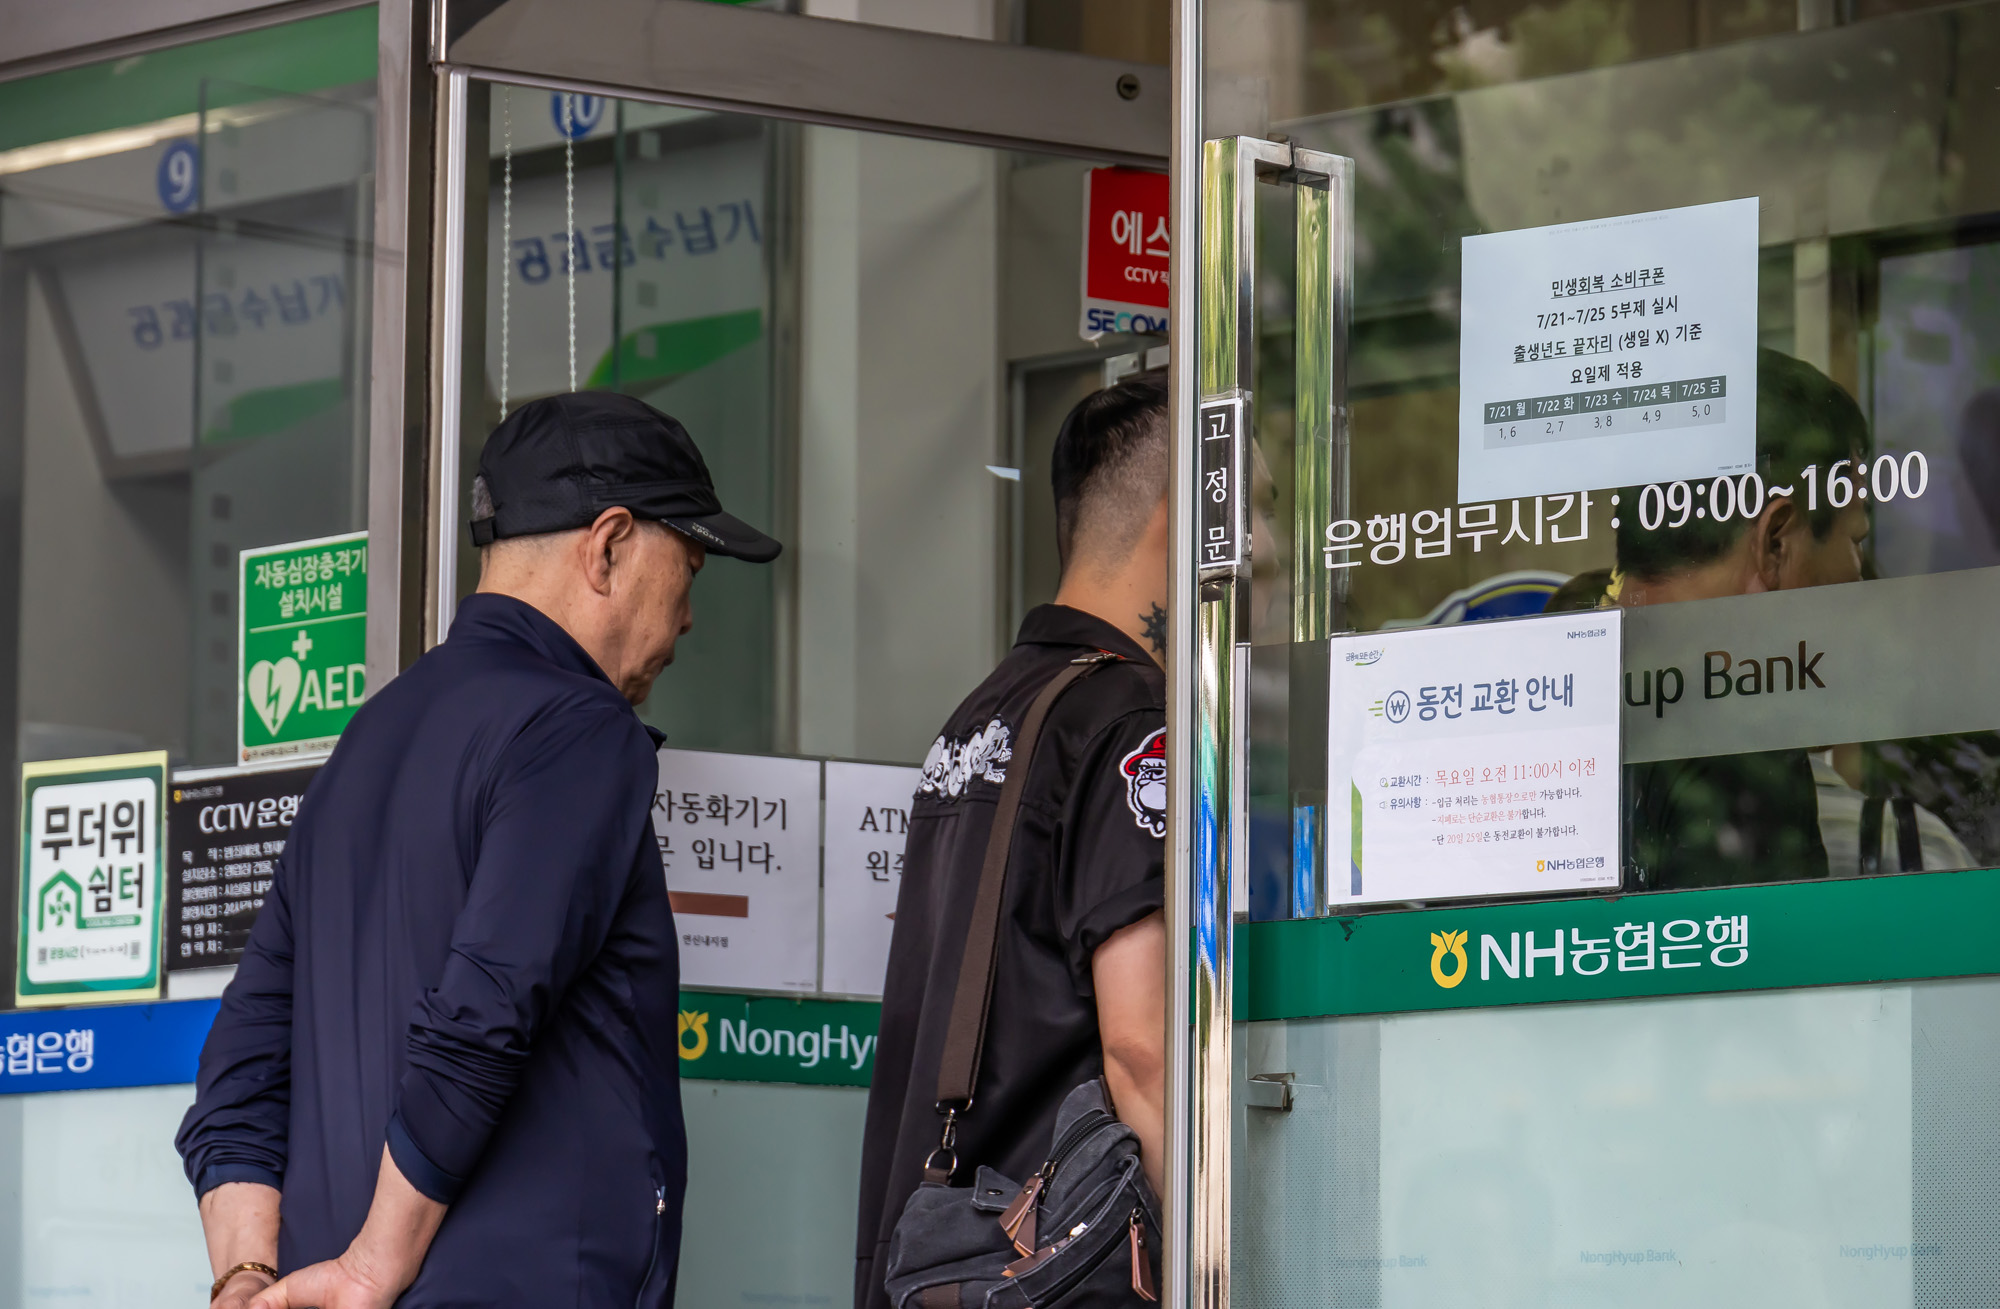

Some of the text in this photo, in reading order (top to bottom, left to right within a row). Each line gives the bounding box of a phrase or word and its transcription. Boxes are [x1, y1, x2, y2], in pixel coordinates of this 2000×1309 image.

[168, 148, 193, 202] 9
[1124, 265, 1159, 284] CCTV
[1551, 266, 1665, 297] 민생회복 소비쿠폰
[1537, 295, 1678, 329] 7/21~7/25 5부제 실시
[1513, 323, 1702, 363] 출생년도 끝자리 (생일 X) 기준
[1570, 360, 1643, 384] 요일제 적용
[1489, 379, 1721, 420] 7/21 월 7/22 화 7/23 수 7/24 목 7/25 금
[1322, 491, 1594, 569] 은행업무시간
[1638, 451, 1929, 531] 09:00~16:00
[255, 546, 367, 589] 자동심장충격기
[279, 582, 342, 619] 설치시설
[298, 663, 367, 714] AED
[1704, 640, 1826, 699] Bank
[1417, 673, 1574, 721] 동전 교환 안내
[1390, 775, 1421, 788] 교환시간
[1434, 767, 1475, 788] 목요일
[1480, 765, 1507, 784] 오전
[1513, 759, 1562, 781] 11:00시
[1569, 757, 1596, 777] 이전
[199, 794, 304, 834] CCTV 운영
[652, 789, 786, 831] 자동화기기
[1390, 797, 1421, 810] 유의사항
[1455, 794, 1479, 807] 처리는
[1481, 791, 1537, 805] 농협통장으로만
[1539, 787, 1582, 801] 가능합니다.
[1468, 810, 1505, 824] 단순교환은
[1507, 808, 1547, 822] 불가합니다.
[41, 800, 144, 861] 무더위
[1447, 833, 1463, 845] 20일
[1493, 829, 1533, 842] 동전교환이
[1536, 825, 1579, 839] 불가합니다.
[692, 838, 782, 874] 입니다.
[1547, 857, 1605, 871] NH농협은행
[88, 862, 143, 913] 쉼터
[1480, 915, 1750, 982] NH농협은행
[0, 1029, 94, 1076] 협은행
[719, 1018, 877, 1070] NongHy
[1646, 1249, 1676, 1262] Bank
